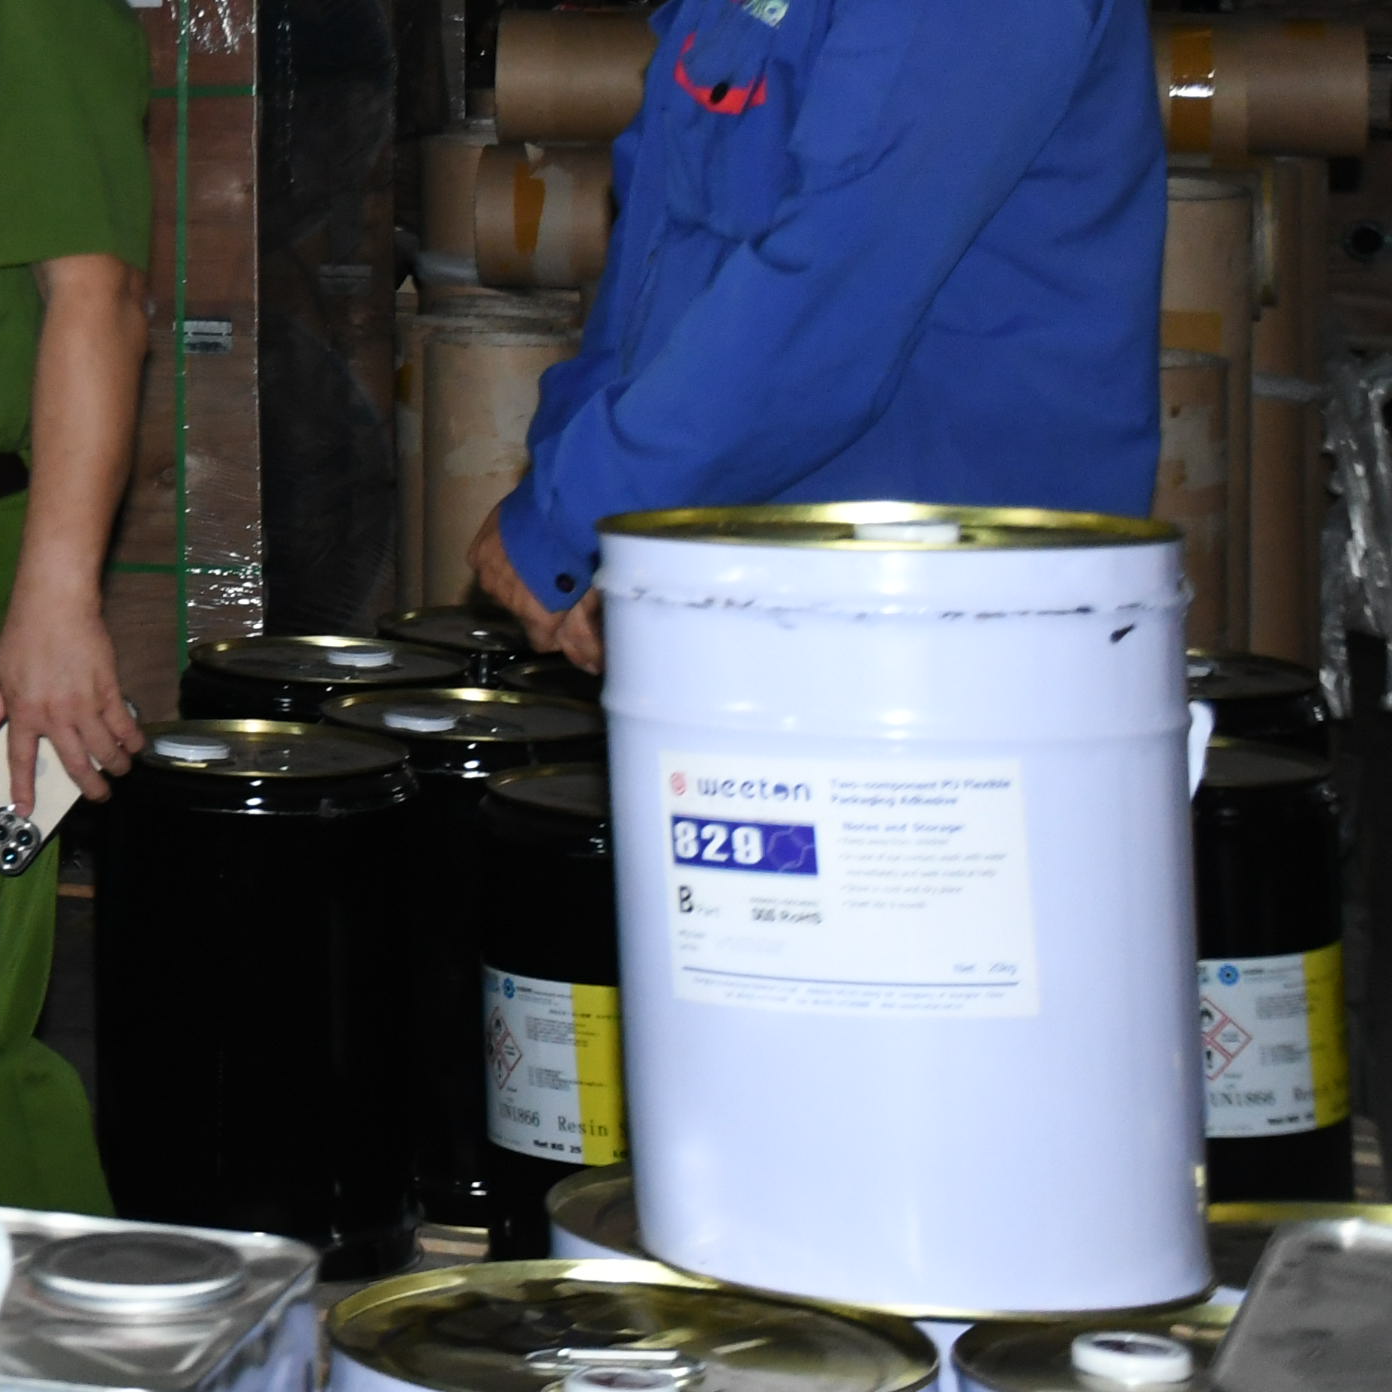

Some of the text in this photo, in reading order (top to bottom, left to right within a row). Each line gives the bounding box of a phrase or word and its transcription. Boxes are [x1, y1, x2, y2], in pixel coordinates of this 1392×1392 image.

[697, 777, 811, 802] weeton
[673, 820, 764, 865] 829
[678, 885, 694, 913] B
[557, 1114, 609, 1138] Resin
